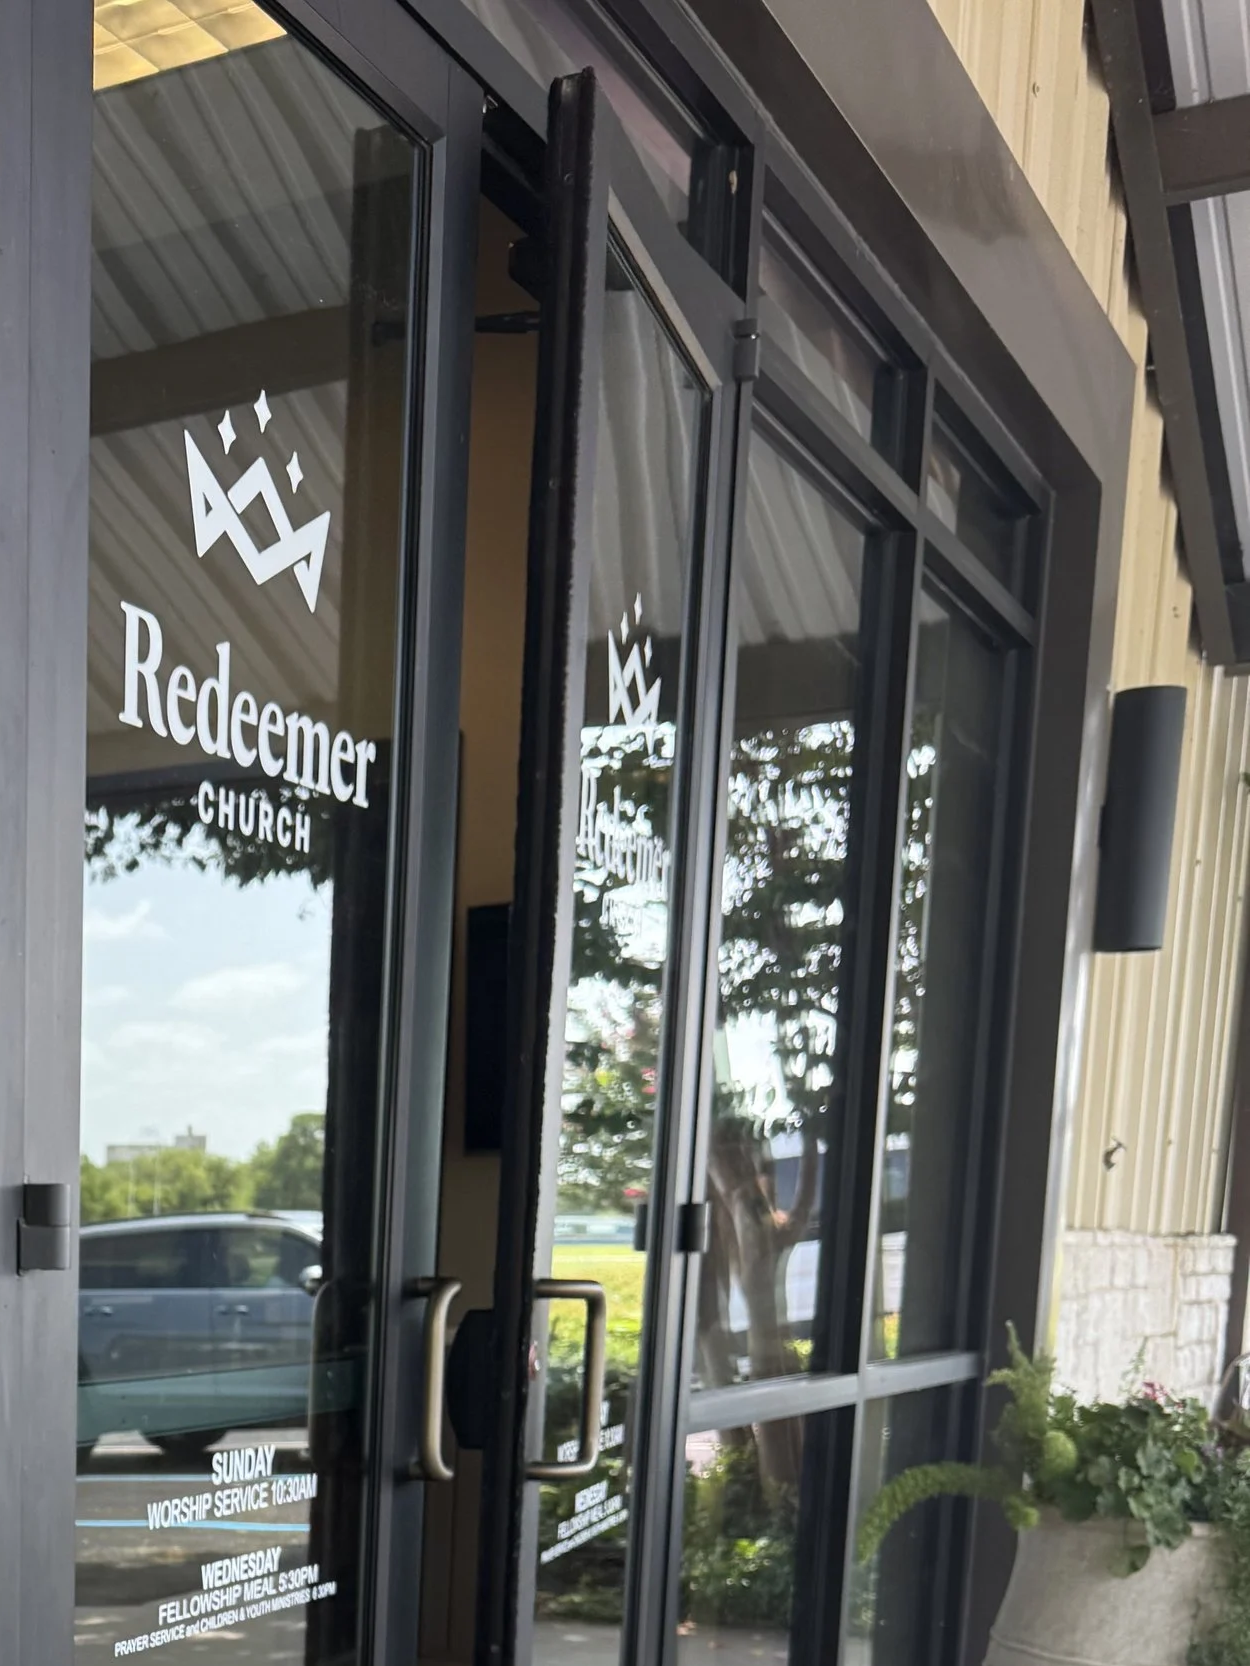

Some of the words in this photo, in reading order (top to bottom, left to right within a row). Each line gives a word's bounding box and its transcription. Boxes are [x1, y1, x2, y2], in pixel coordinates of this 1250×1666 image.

[118, 600, 376, 808] Redeemer
[197, 780, 311, 854] CHURCH
[211, 1444, 276, 1486] SUNDAY
[147, 1492, 213, 1530] WORSHIP
[213, 1481, 269, 1518] SERVICE
[271, 1473, 318, 1506] 10:30AM
[201, 1546, 282, 1590] WEDNESDAY
[114, 1634, 149, 1658] PRAYER
[149, 1623, 185, 1648] SERVICE
[185, 1620, 200, 1637] and
[200, 1609, 239, 1633] CHILDREN
[239, 1606, 246, 1621] &
[245, 1600, 271, 1619] YOUTH
[271, 1588, 310, 1611] MINISTRIES
[158, 1584, 242, 1626] FELLOWSHIP
[243, 1575, 277, 1602] MEAL
